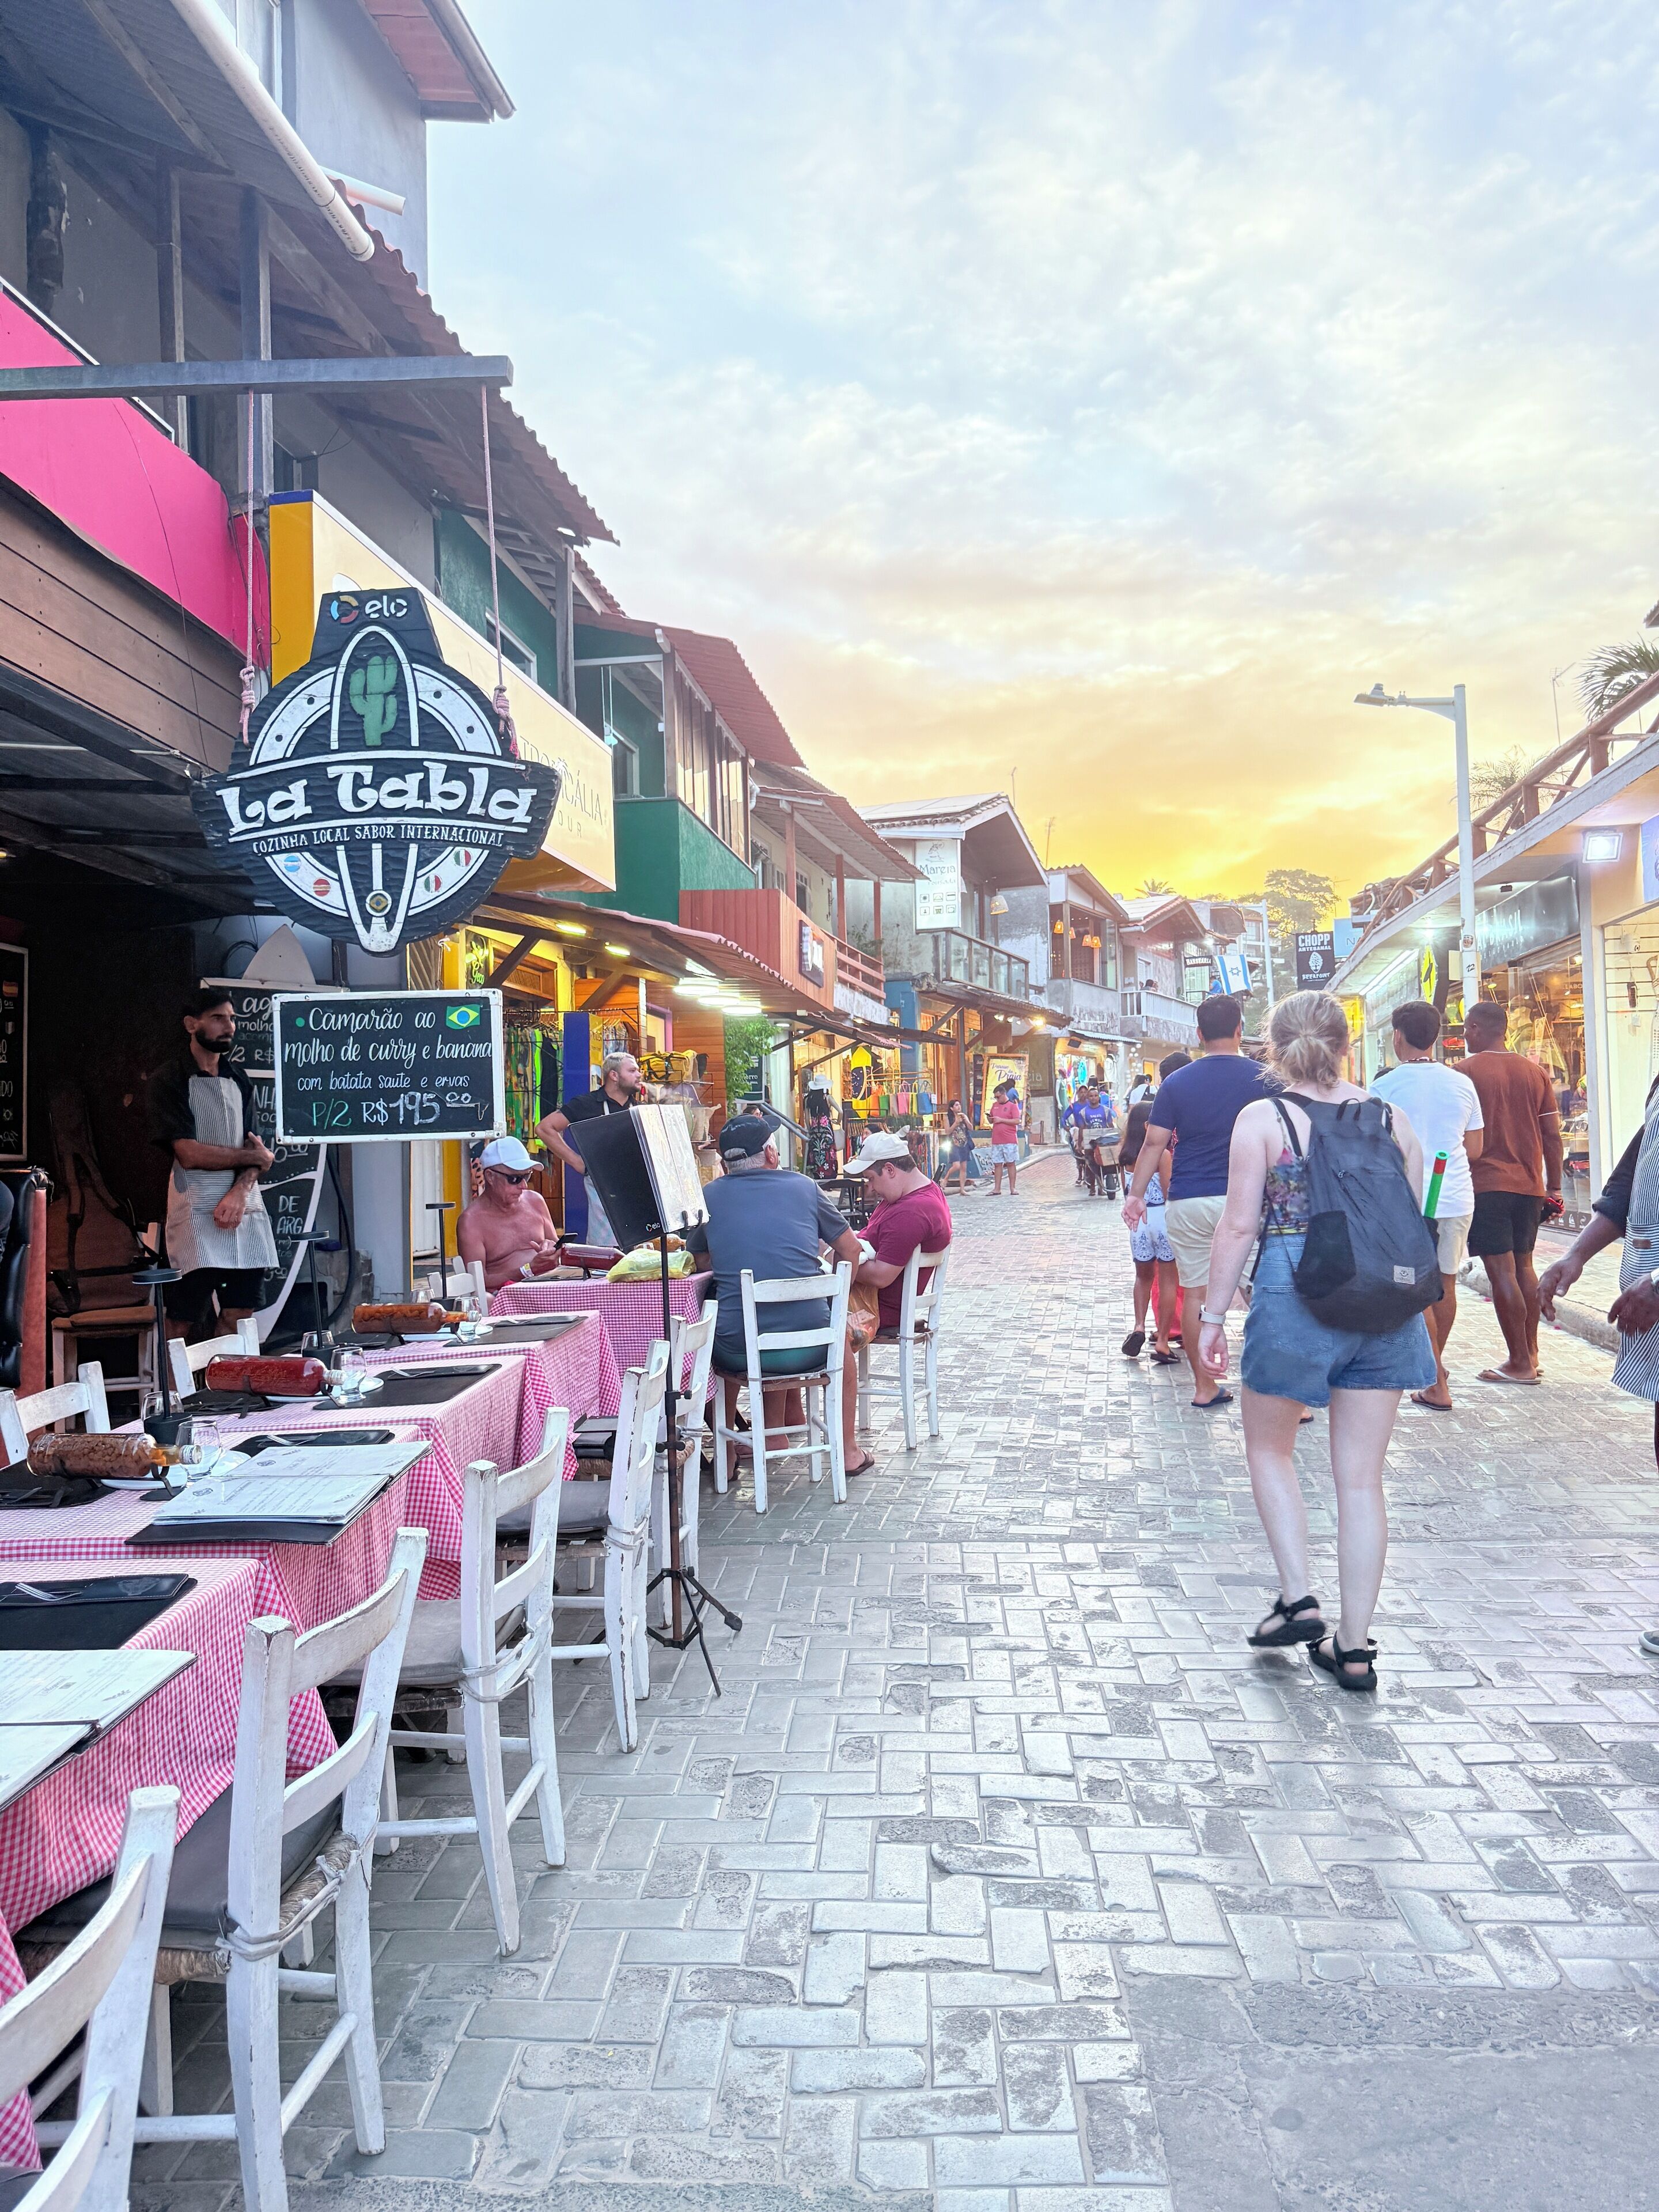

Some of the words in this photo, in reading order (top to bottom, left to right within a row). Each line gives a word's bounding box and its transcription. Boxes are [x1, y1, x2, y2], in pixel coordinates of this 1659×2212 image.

[215, 779, 312, 835] La
[327, 761, 538, 823] Tabla
[252, 834, 309, 856] COZINHA
[312, 828, 350, 846] LOCAL
[355, 825, 396, 839] SABOR
[401, 824, 504, 848] INTERNACIONAL
[1298, 934, 1331, 948] CHOPP
[1302, 972, 1331, 980] BEERPOINT
[309, 1007, 403, 1033] Camarão
[415, 1012, 435, 1028] ao
[285, 1037, 334, 1067] molho
[341, 1036, 361, 1061] de
[369, 1038, 416, 1069] curry
[422, 1045, 430, 1059] e
[435, 1034, 491, 1059] banana
[298, 1077, 322, 1090] com
[329, 1070, 372, 1090] batata
[421, 1076, 428, 1088] e
[435, 1075, 470, 1087] ervas
[995, 1069, 1021, 1082] Praia
[313, 1098, 352, 1130] P/2
[278, 1195, 301, 1213] DE
[276, 1216, 304, 1234] ARG
